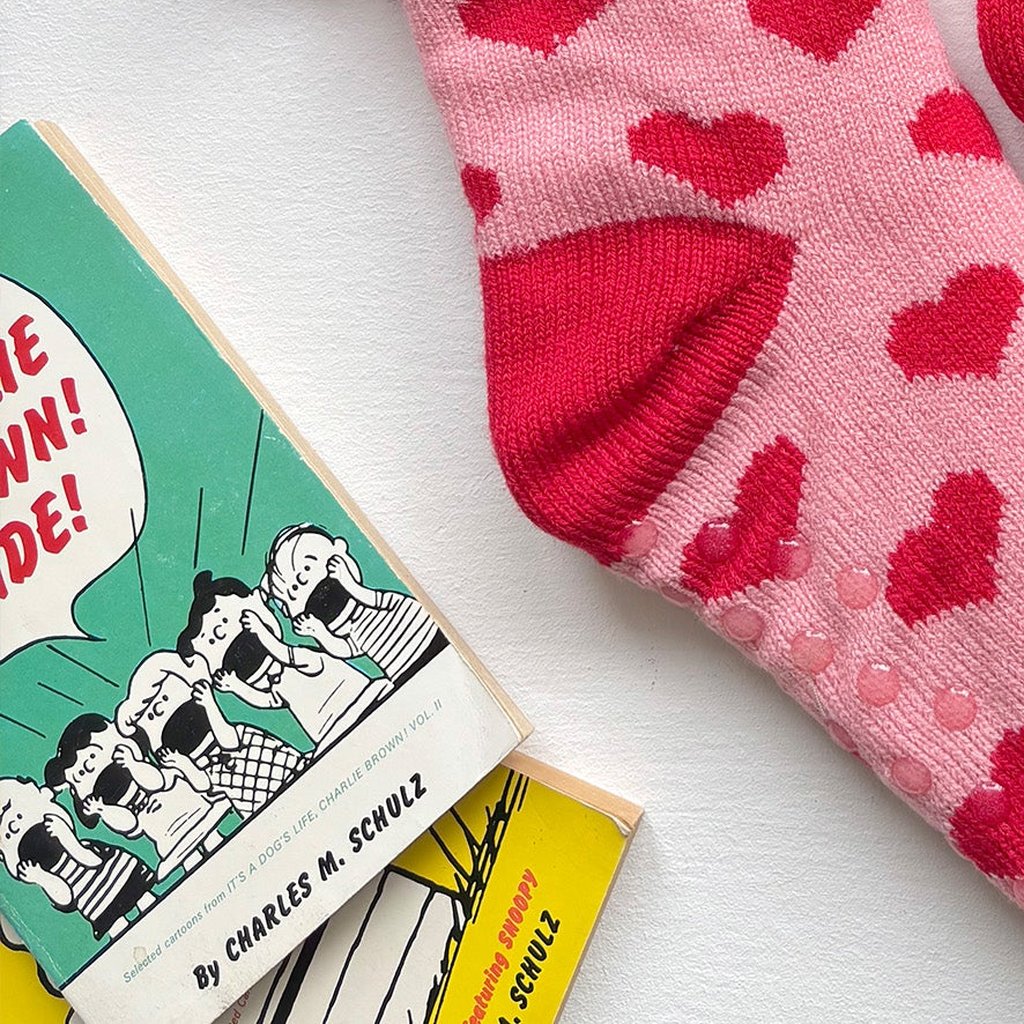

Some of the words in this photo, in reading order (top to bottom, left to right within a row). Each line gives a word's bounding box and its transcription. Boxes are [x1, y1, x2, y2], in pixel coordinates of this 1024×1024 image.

[123, 945, 163, 984] Selected
[164, 911, 204, 949] cartoons
[203, 890, 227, 914] from
[226, 870, 247, 894] IT'S
[248, 862, 258, 876] A
[257, 833, 293, 867] DOG'S
[293, 809, 319, 835] LIFE,
[318, 768, 364, 812] CHARLIE
[364, 727, 410, 772] BROWN!
[408, 709, 434, 732] VOL.
[192, 960, 220, 990] By
[225, 872, 312, 962] CHARLES
[317, 850, 346, 882] M.
[348, 772, 427, 854] SCHULZ
[497, 868, 538, 951] SNOOPY
[509, 909, 561, 1010] SCHULZ
